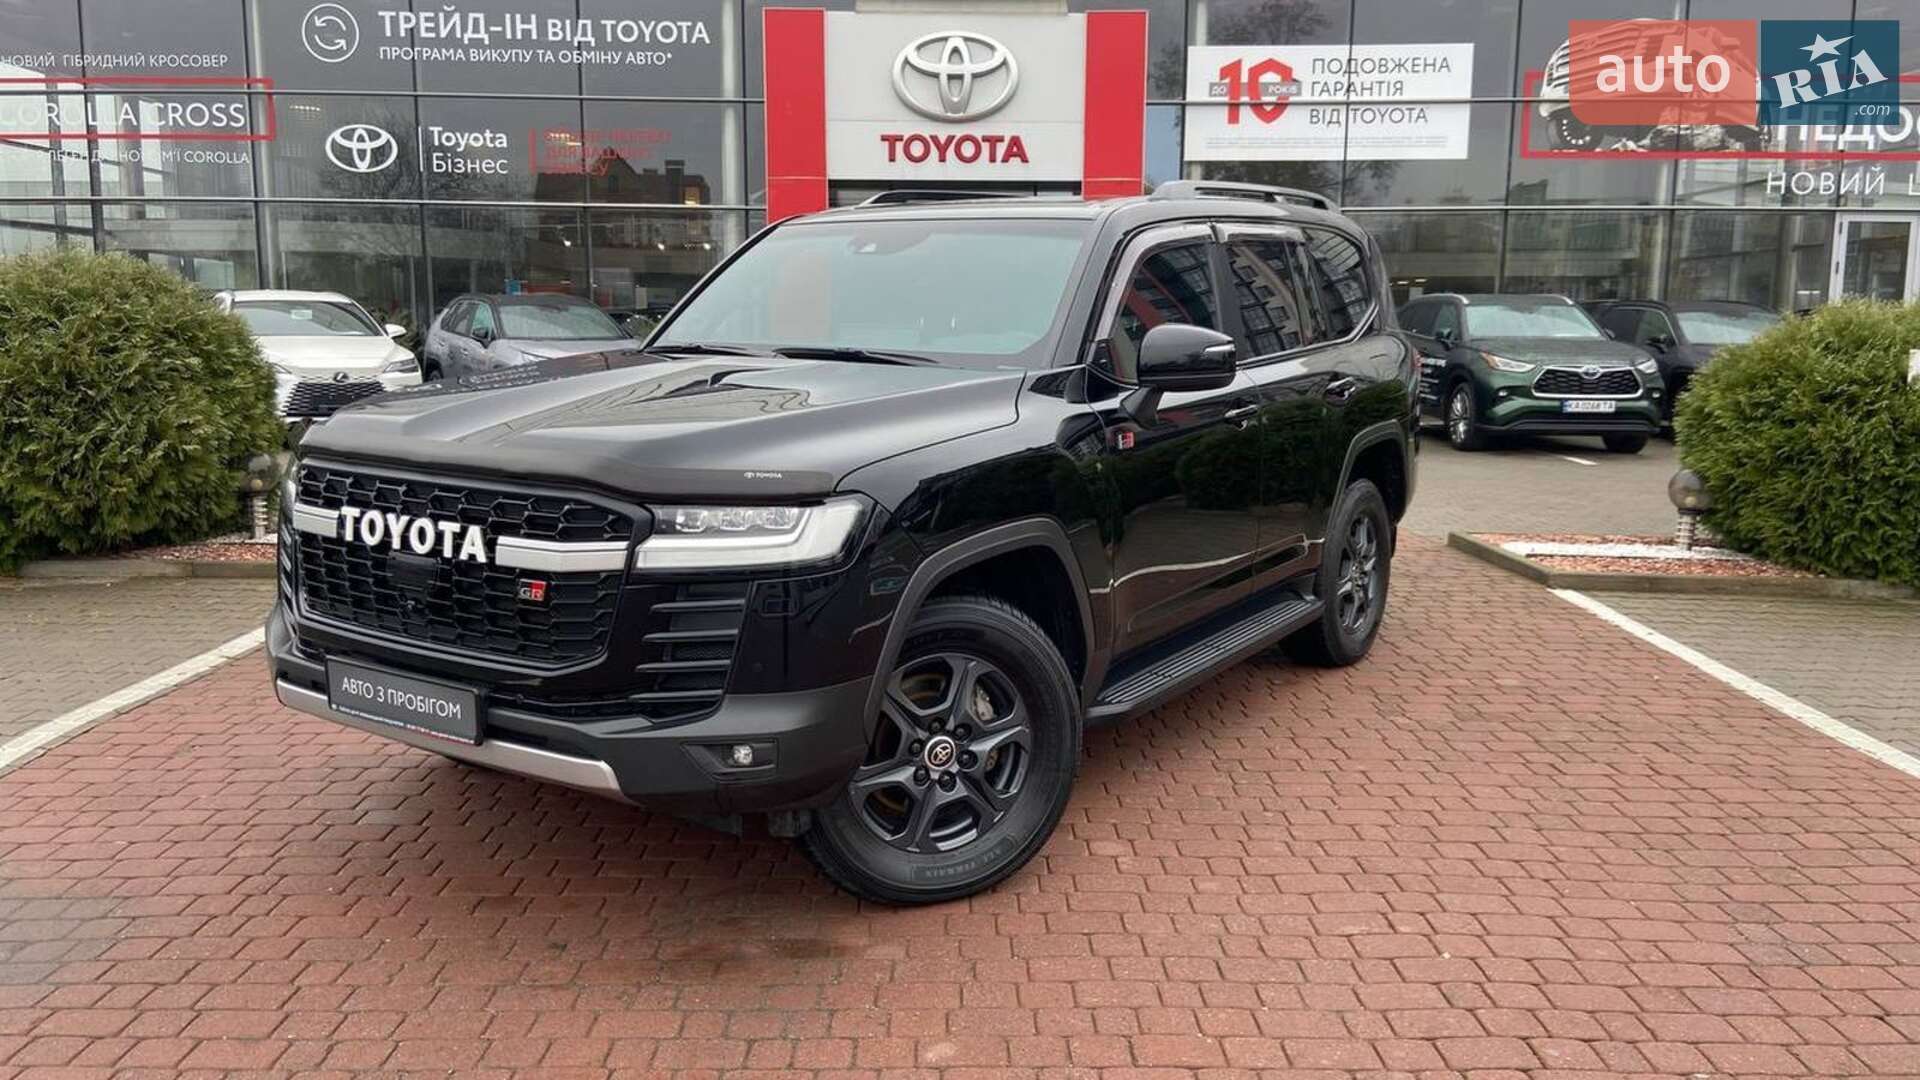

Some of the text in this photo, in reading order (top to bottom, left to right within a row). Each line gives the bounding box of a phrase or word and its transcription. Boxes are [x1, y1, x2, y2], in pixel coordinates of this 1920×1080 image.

[377, 4, 711, 47] ТРЕЙД-ІН ВІД TOYOTA
[1, 52, 229, 69] НОВИЙ ГІБРИДНИЙ КРОСОВЕР
[379, 46, 466, 61] ПРОГРАМА
[469, 48, 533, 63] ВИКУПУ
[537, 49, 556, 63] ТА
[558, 49, 622, 64] ОБМІНУ
[1312, 56, 1451, 77] ПОДОВЖЕНА
[1310, 80, 1404, 97] ГАРАНТІЯ
[148, 102, 246, 127] CROSS
[1309, 107, 1428, 128] ВІД TOYOTA
[429, 126, 508, 152] Toyota
[880, 134, 1029, 164] TOYOTA
[184, 150, 250, 163] COROLLA
[432, 152, 508, 175] Бізнес
[1766, 165, 1885, 195] НОВИЙ
[341, 506, 487, 563] TOYOTA
[342, 676, 374, 698] АВТО
[377, 686, 385, 702] З
[388, 688, 462, 720] ПРОБІГОМ
